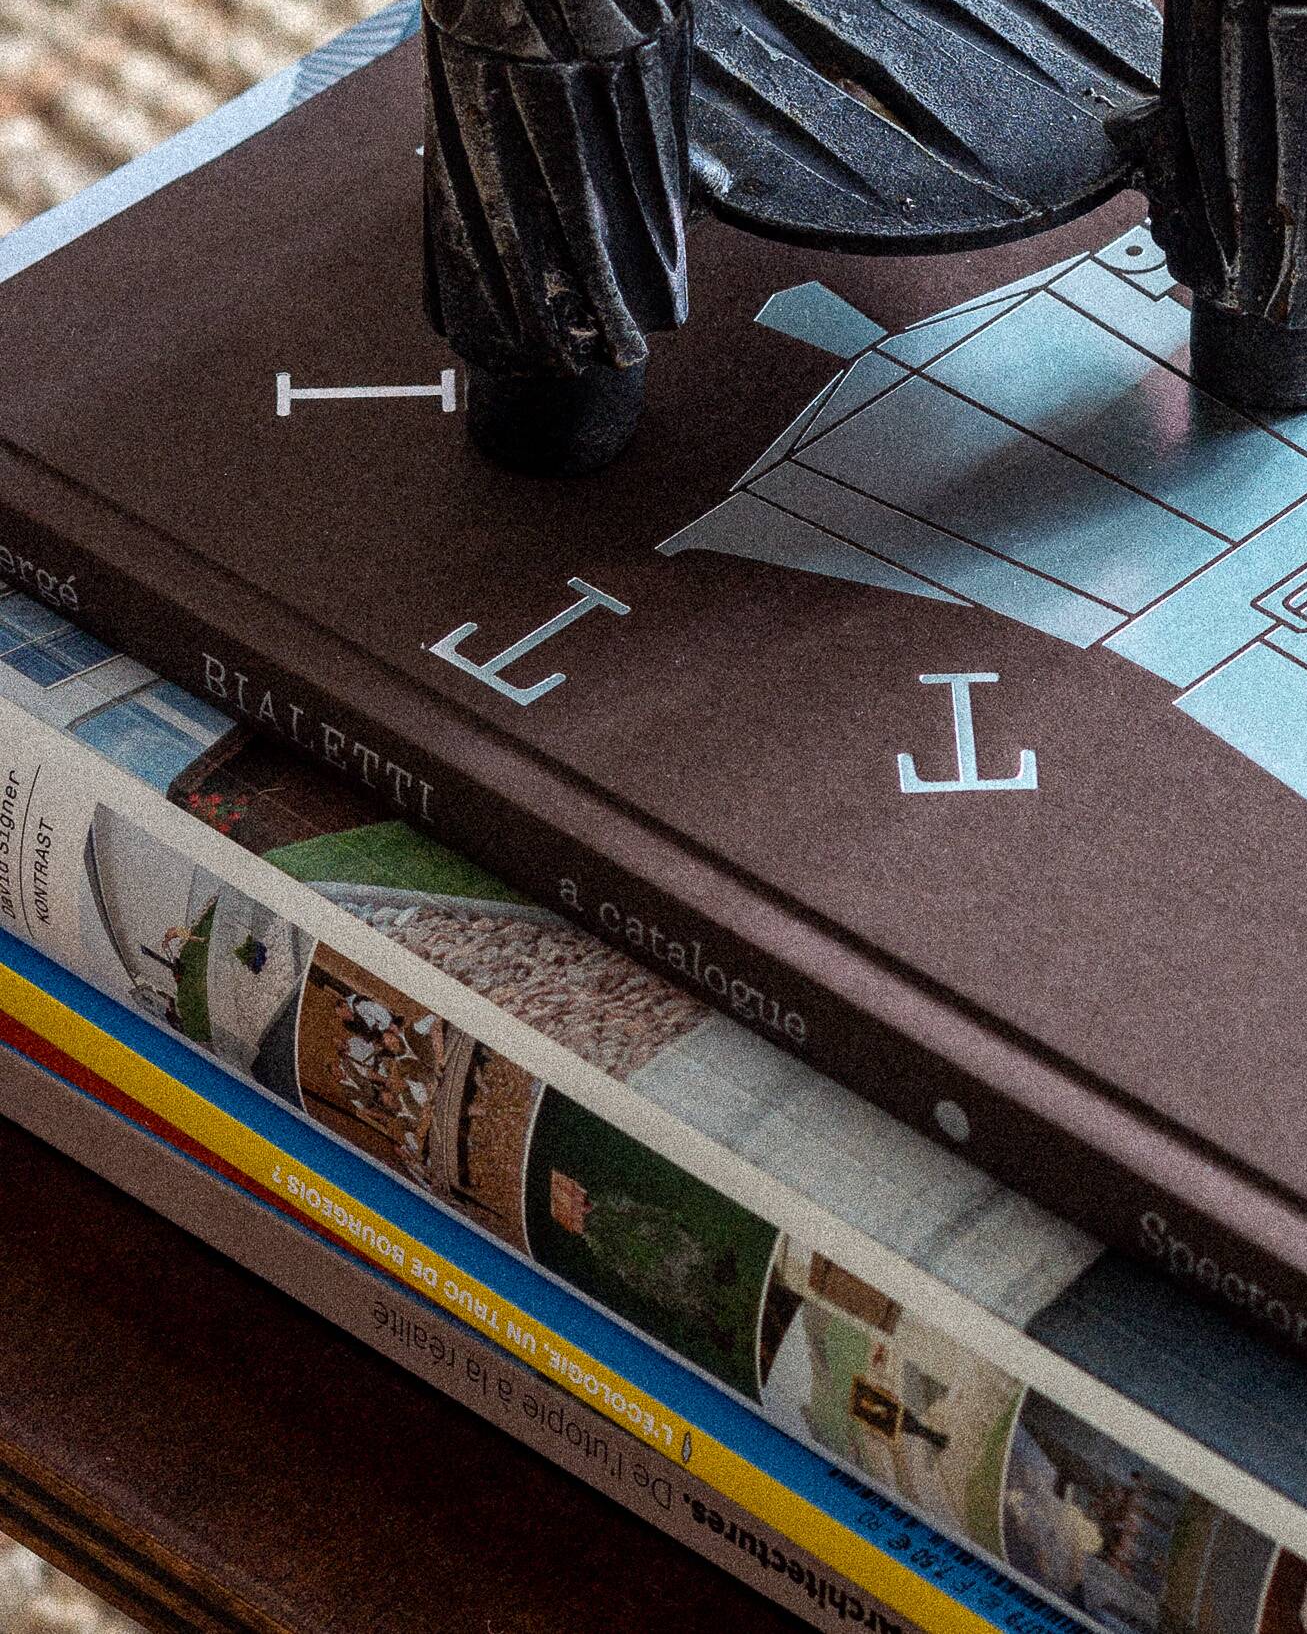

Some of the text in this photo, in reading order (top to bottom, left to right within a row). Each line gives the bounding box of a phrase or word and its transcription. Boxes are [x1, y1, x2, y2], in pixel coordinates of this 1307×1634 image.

[201, 652, 436, 822] BIALETTI
[33, 817, 54, 925] KONTRAST
[559, 878, 806, 1041] a catalogue
[286, 1173, 406, 1265] BOURGEOIS
[410, 1259, 440, 1287] DE
[442, 1280, 500, 1330] TRUC
[373, 1300, 457, 1368] réalité
[506, 1320, 539, 1355] UN
[466, 1365, 488, 1396] la
[497, 1377, 514, 1414] à
[632, 1464, 672, 1510] De
